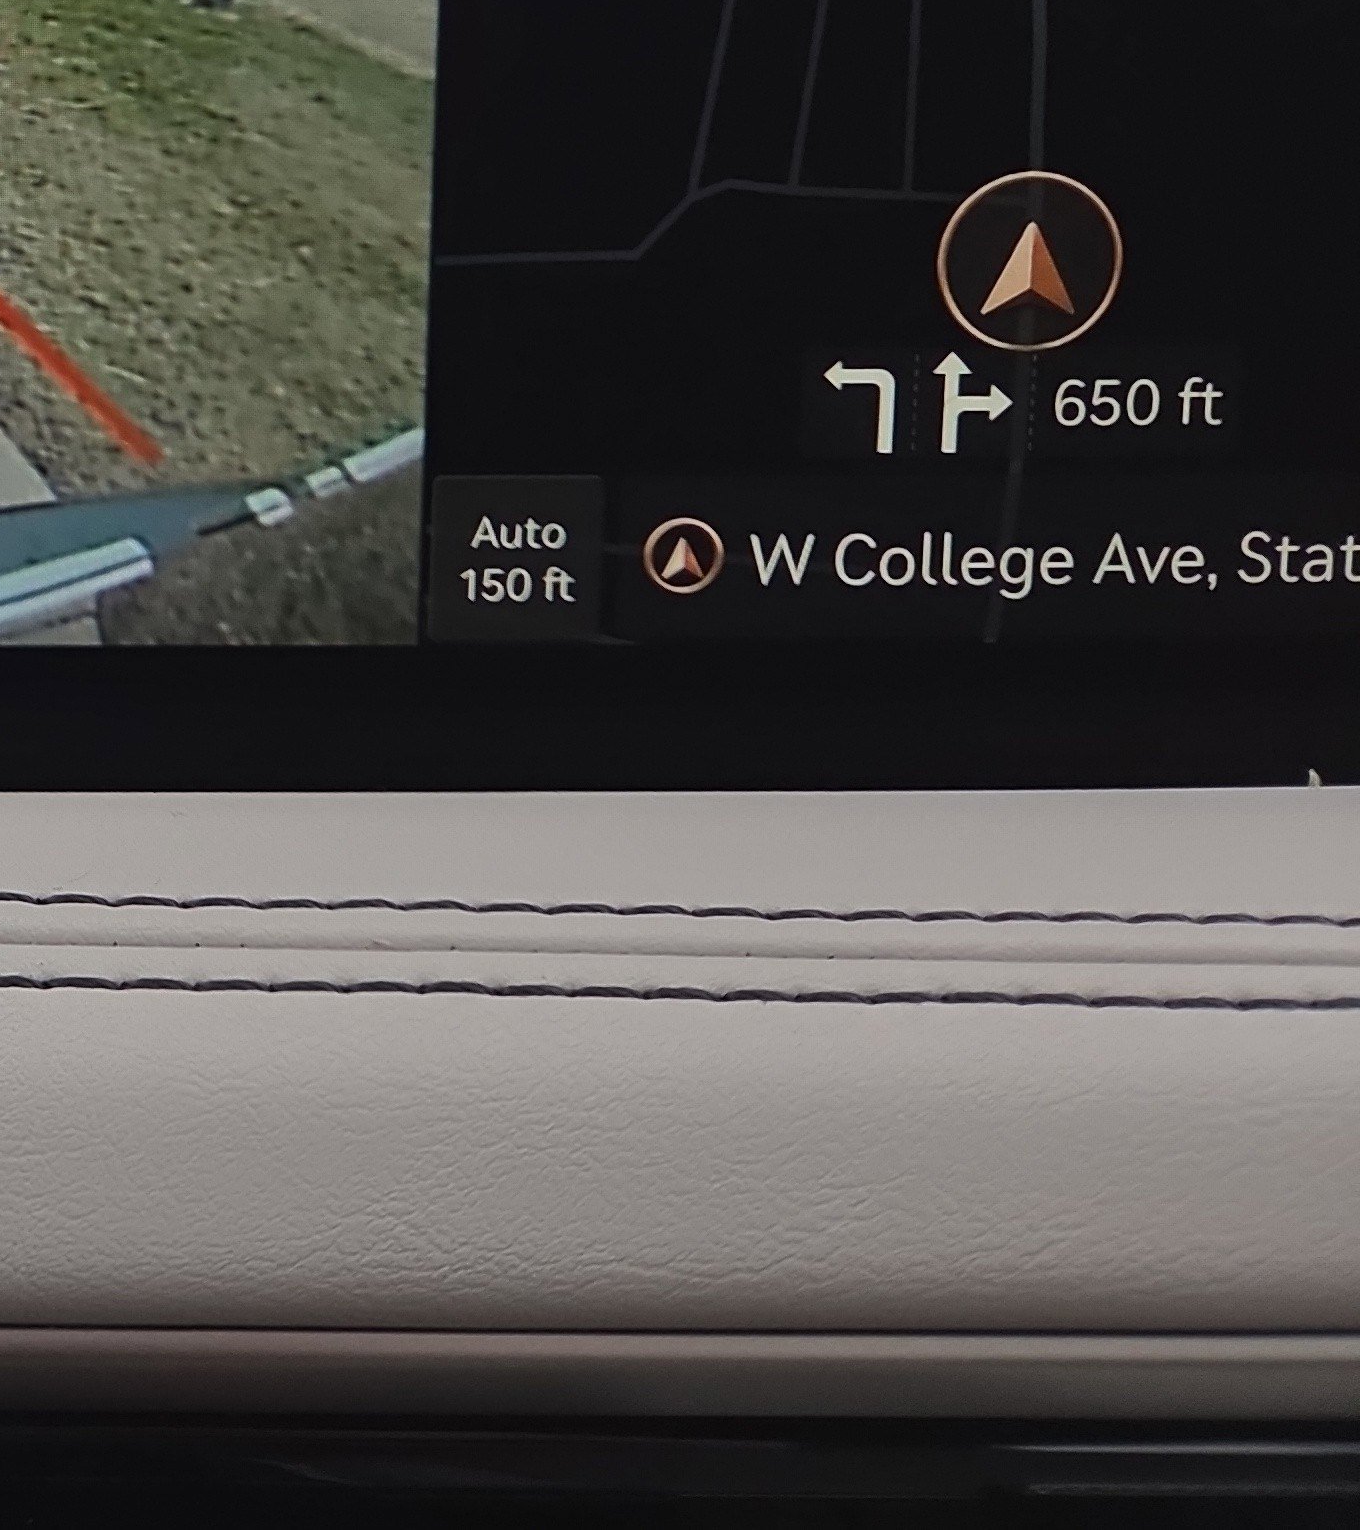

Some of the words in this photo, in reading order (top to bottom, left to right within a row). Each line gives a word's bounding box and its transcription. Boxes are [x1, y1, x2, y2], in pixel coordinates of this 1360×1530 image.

[1054, 378, 1160, 427] 650
[1177, 377, 1224, 426] ft
[470, 515, 567, 550] Auto
[460, 567, 530, 602] 150
[541, 566, 576, 602] ft
[749, 533, 816, 586] W
[834, 532, 1075, 600] College
[1092, 532, 1218, 591] Ave,
[1237, 530, 1360, 584] Stat
